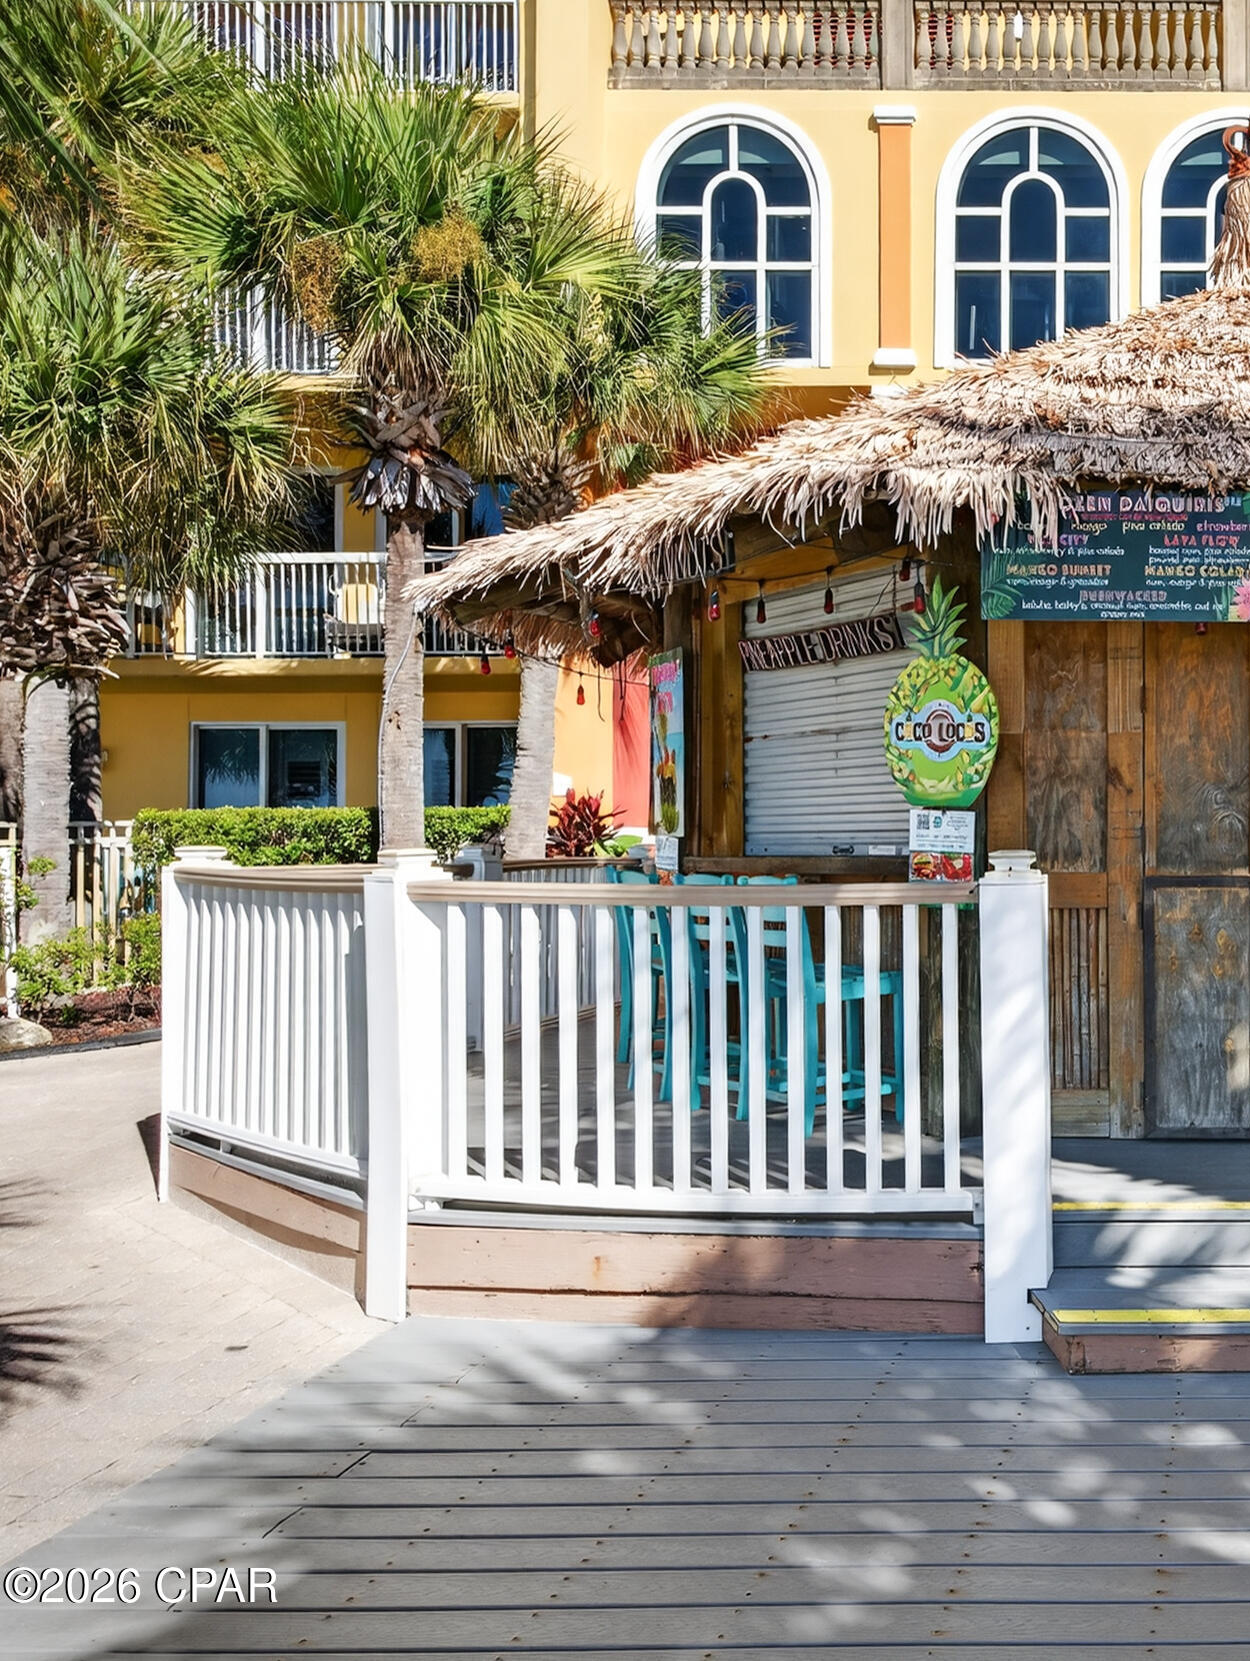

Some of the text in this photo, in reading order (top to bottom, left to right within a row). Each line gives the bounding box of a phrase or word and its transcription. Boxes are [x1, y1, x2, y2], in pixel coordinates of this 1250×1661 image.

[1119, 495, 1226, 513] DAIQUIRIS
[1143, 564, 1196, 578] MANGO
[738, 616, 895, 671] PINEAPPLE DRINKS
